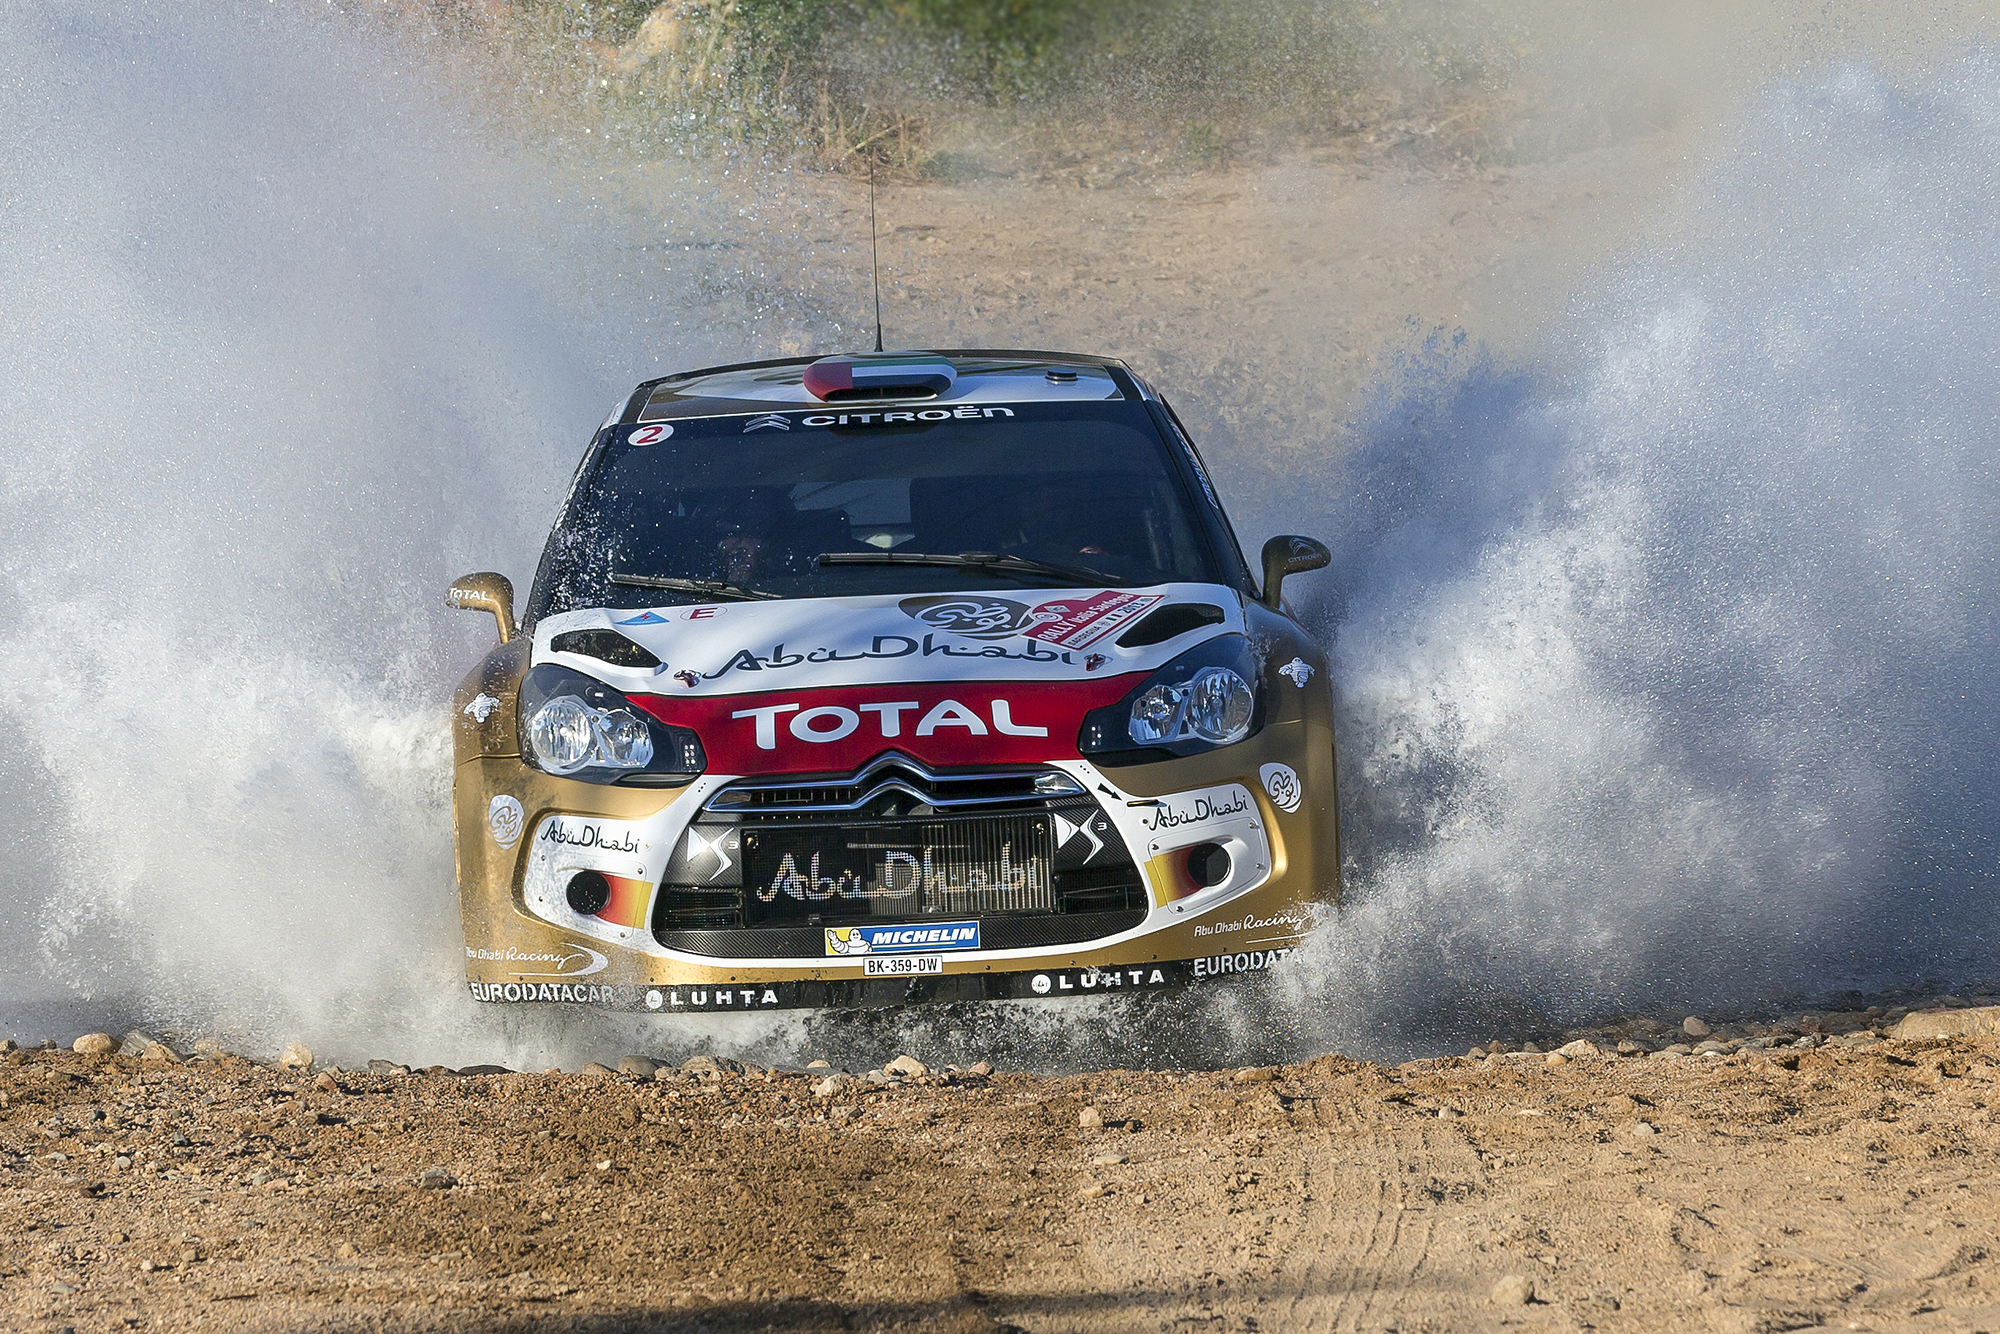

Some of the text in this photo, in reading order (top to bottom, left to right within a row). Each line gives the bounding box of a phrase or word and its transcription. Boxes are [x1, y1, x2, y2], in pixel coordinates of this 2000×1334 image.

[637, 425, 664, 444] 2
[448, 587, 491, 601] TOTAL
[689, 606, 719, 620] E
[1037, 620, 1077, 641] RALLY
[701, 633, 1079, 680] Abu Dhabi
[731, 699, 1049, 750] TOTAL
[1149, 790, 1249, 831] Abu Dhabi
[540, 819, 641, 853] Abu Dhabi
[756, 841, 1042, 902] Abu Dhabi
[871, 927, 976, 945] MICHELIN
[1193, 913, 1307, 938] Abu Dhabi Racing
[477, 948, 505, 961] Dhabi
[505, 945, 585, 970] Racing
[868, 958, 938, 973] BK-359-DW
[1059, 969, 1165, 990] LUHTA
[471, 982, 615, 1003] EURODATACAR
[670, 988, 779, 1007] LUHTA
